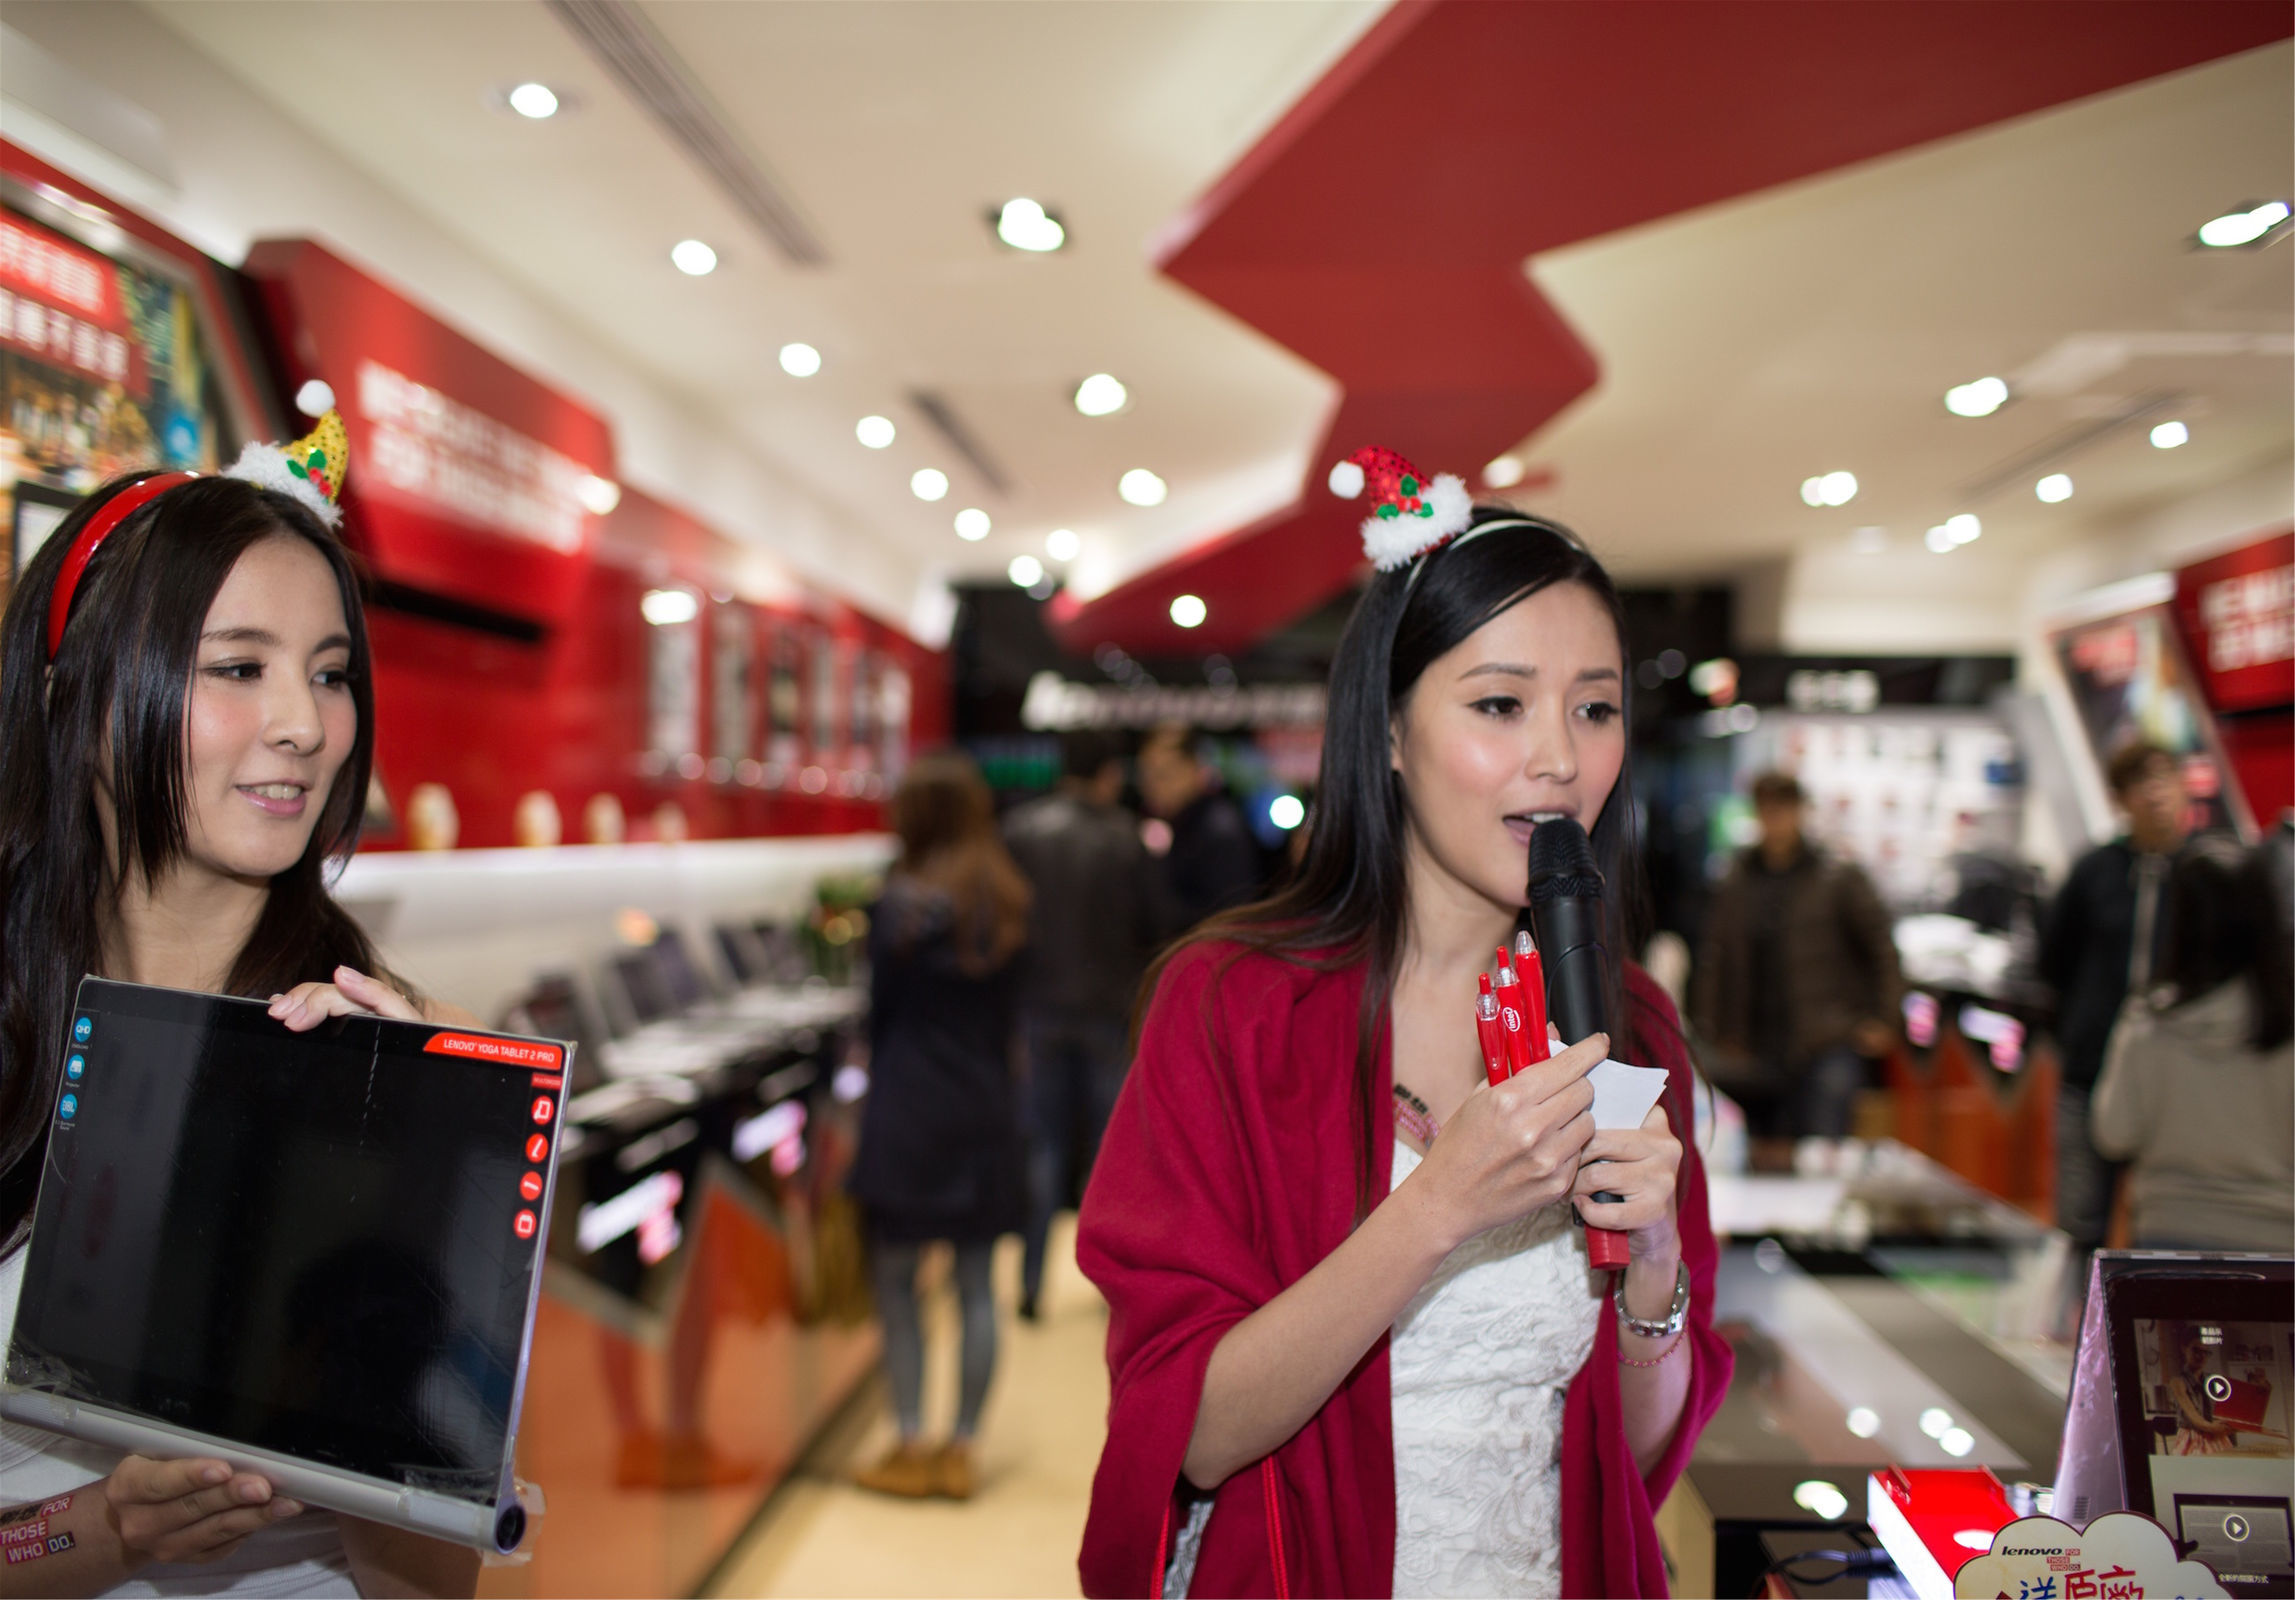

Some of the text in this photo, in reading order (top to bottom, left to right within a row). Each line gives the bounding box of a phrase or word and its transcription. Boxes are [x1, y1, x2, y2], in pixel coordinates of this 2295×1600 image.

[478, 1043, 499, 1054] YOGA
[501, 1046, 529, 1059] TABLET
[530, 1051, 536, 1060] 2
[536, 1052, 555, 1063] PRO
[42, 1497, 71, 1516] FOR
[1, 1521, 47, 1545] THOSE
[8, 1535, 75, 1563] WHO DO.
[2002, 1546, 2063, 1556] lenovo
